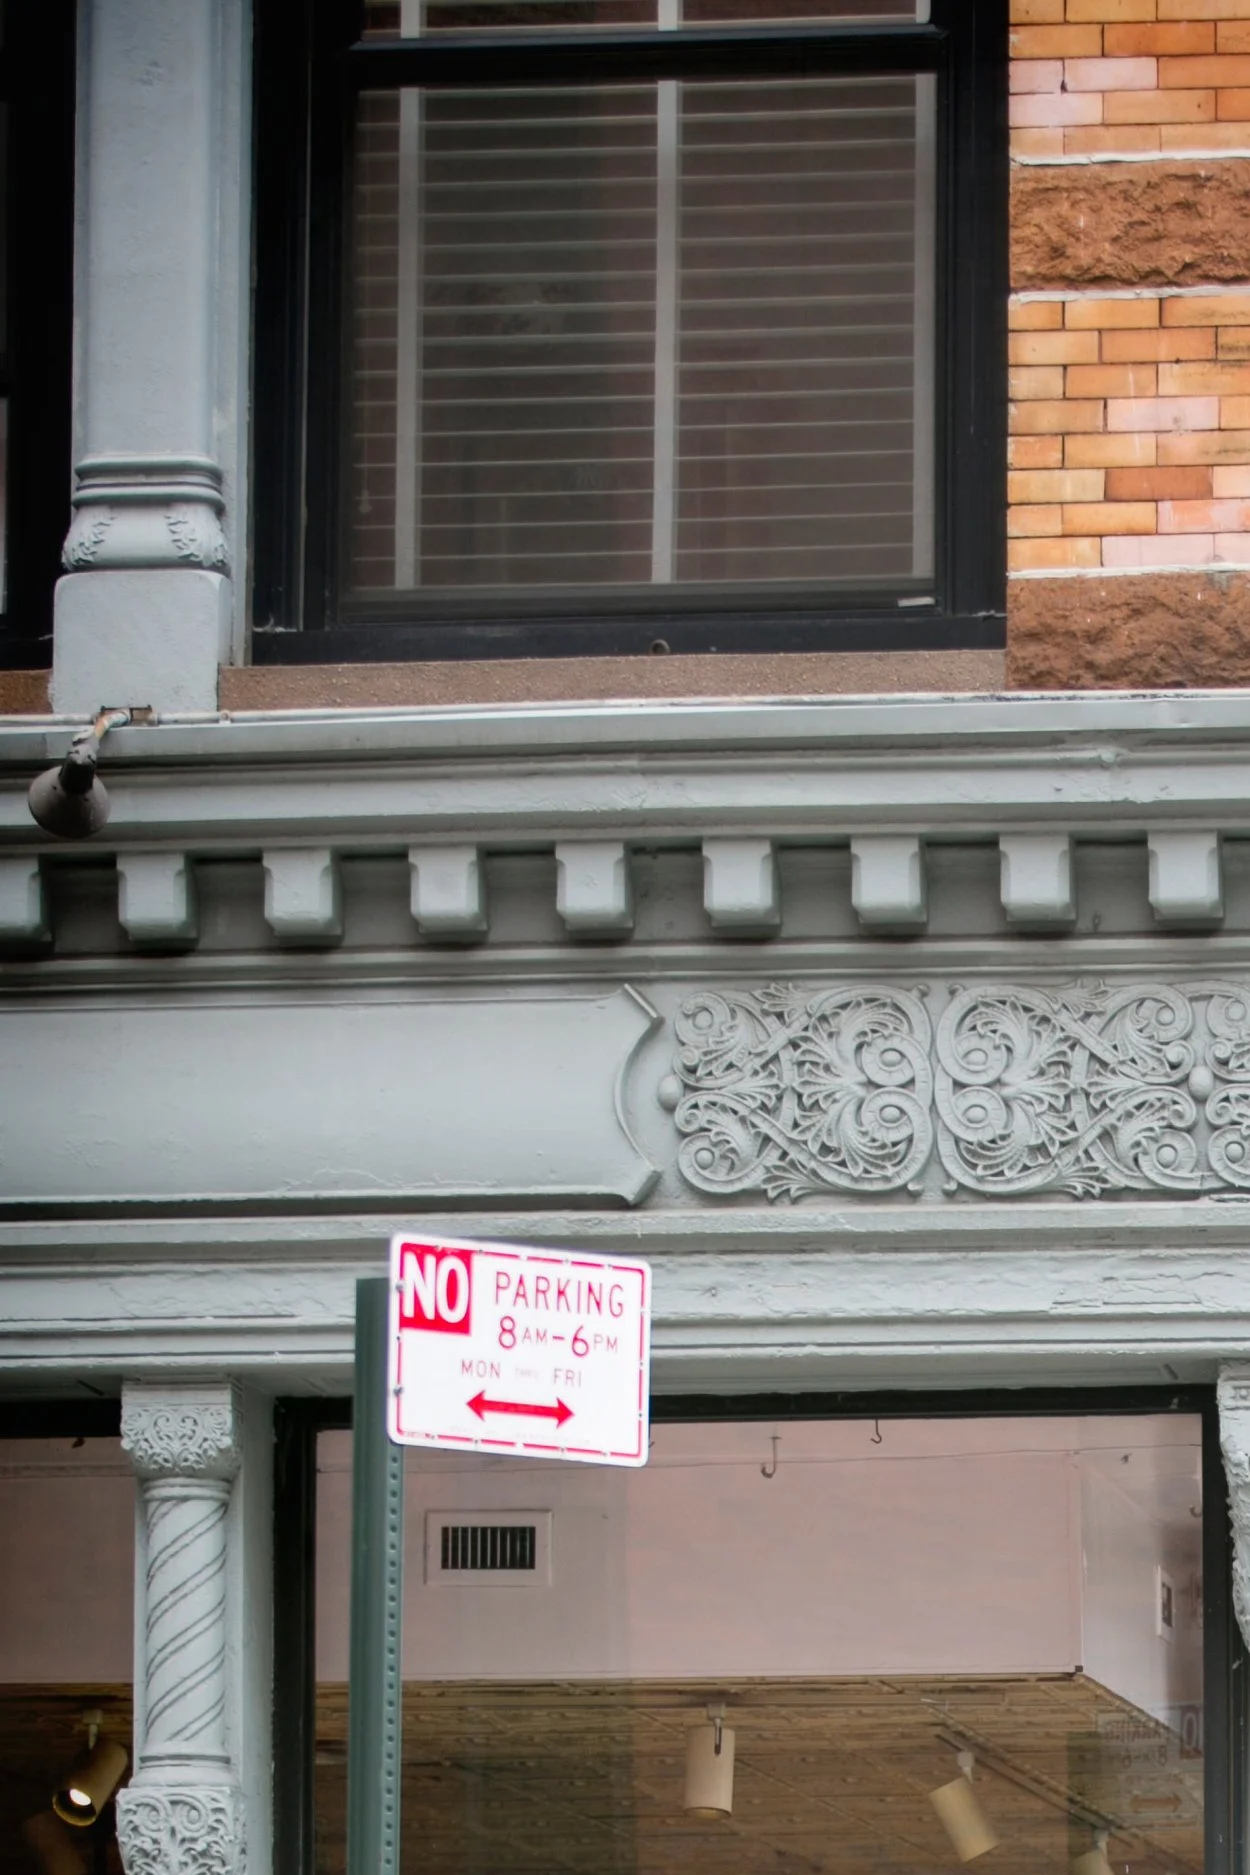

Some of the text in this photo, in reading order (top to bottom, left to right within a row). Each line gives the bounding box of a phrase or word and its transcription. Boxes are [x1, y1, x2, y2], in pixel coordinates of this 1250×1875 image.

[403, 1251, 624, 1324] NO PARKING
[461, 1359, 500, 1380] MON
[553, 1368, 582, 1388] FRI
